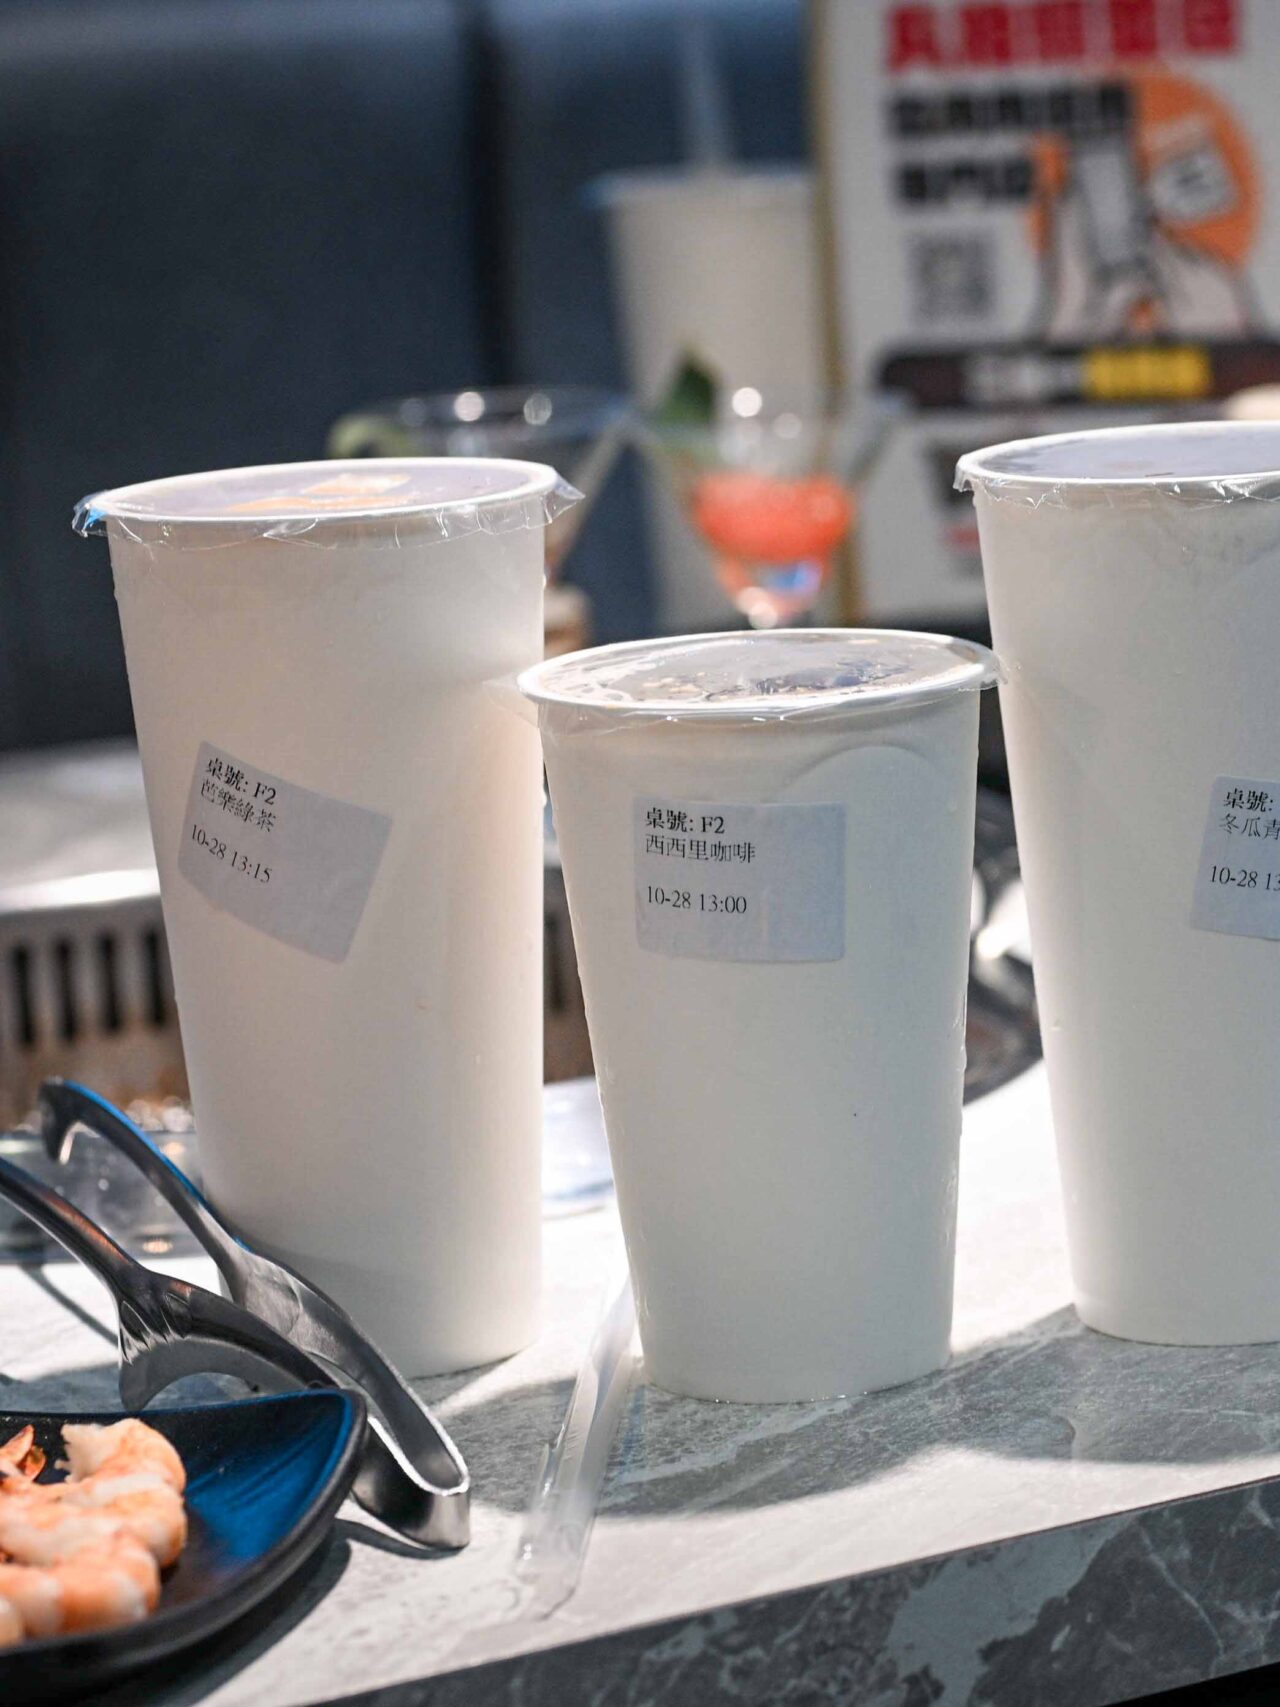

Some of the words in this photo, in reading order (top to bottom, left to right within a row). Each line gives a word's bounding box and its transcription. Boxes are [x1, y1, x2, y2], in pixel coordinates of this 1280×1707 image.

[200, 779, 277, 832] 芭樂綠茶
[253, 782, 277, 805] F2
[1223, 788, 1274, 813] 桌號:
[645, 807, 694, 832] 桌號:
[701, 816, 725, 834] F2
[192, 824, 227, 859] 10-28
[231, 851, 273, 883] 13:15
[645, 834, 756, 863] 西西里咖啡
[1209, 866, 1258, 888] 10-28
[647, 886, 691, 909] 10-28
[699, 893, 747, 914] 13:00
